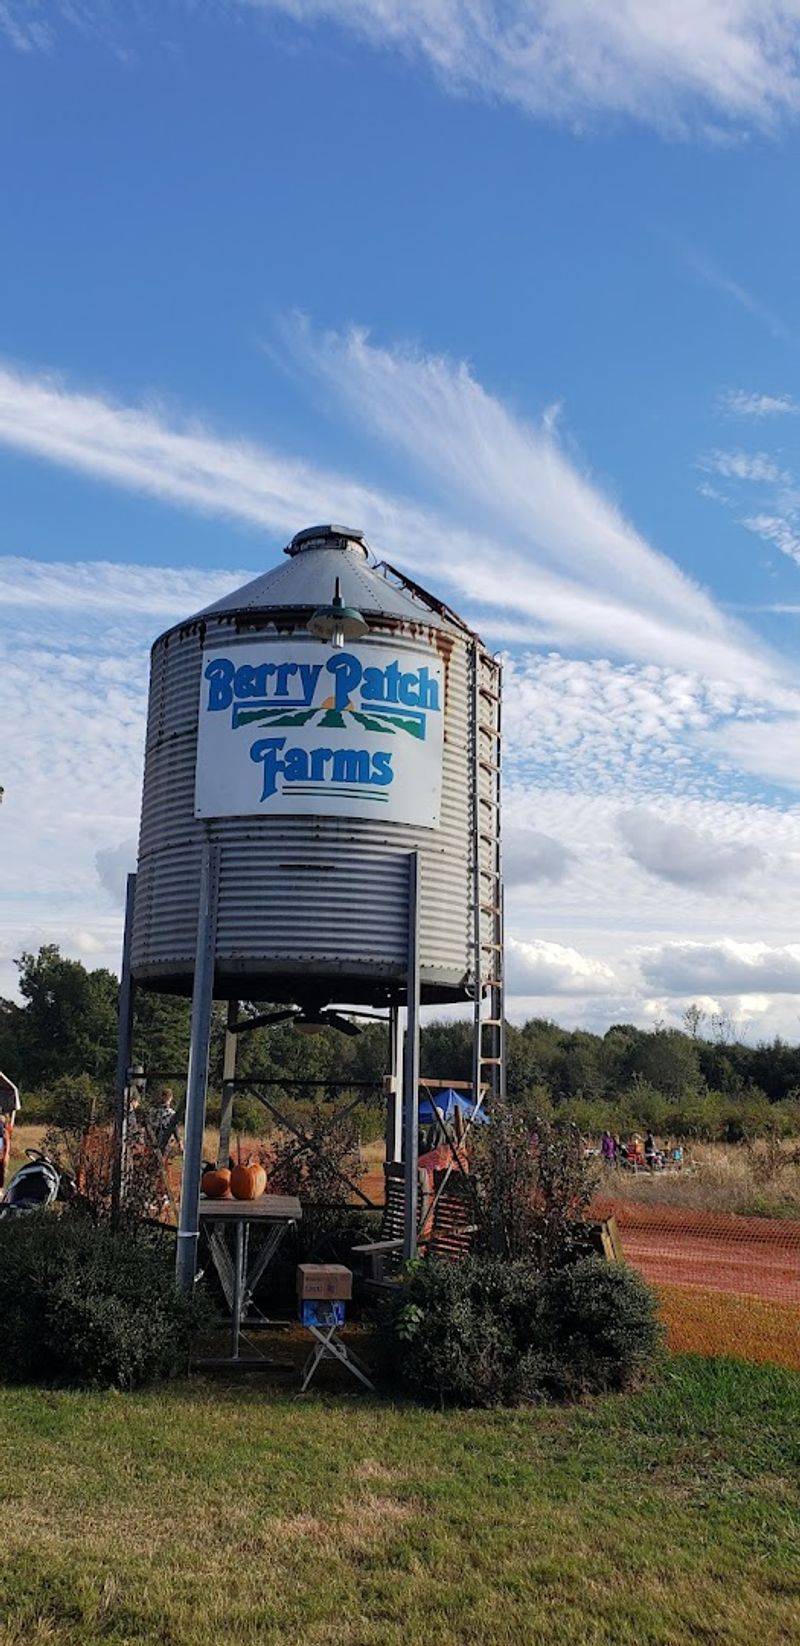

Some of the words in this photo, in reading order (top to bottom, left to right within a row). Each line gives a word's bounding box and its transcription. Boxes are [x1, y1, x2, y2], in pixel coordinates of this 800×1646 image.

[204, 657, 325, 712] Berry
[325, 652, 441, 712] Patch
[249, 736, 394, 803] Farms
